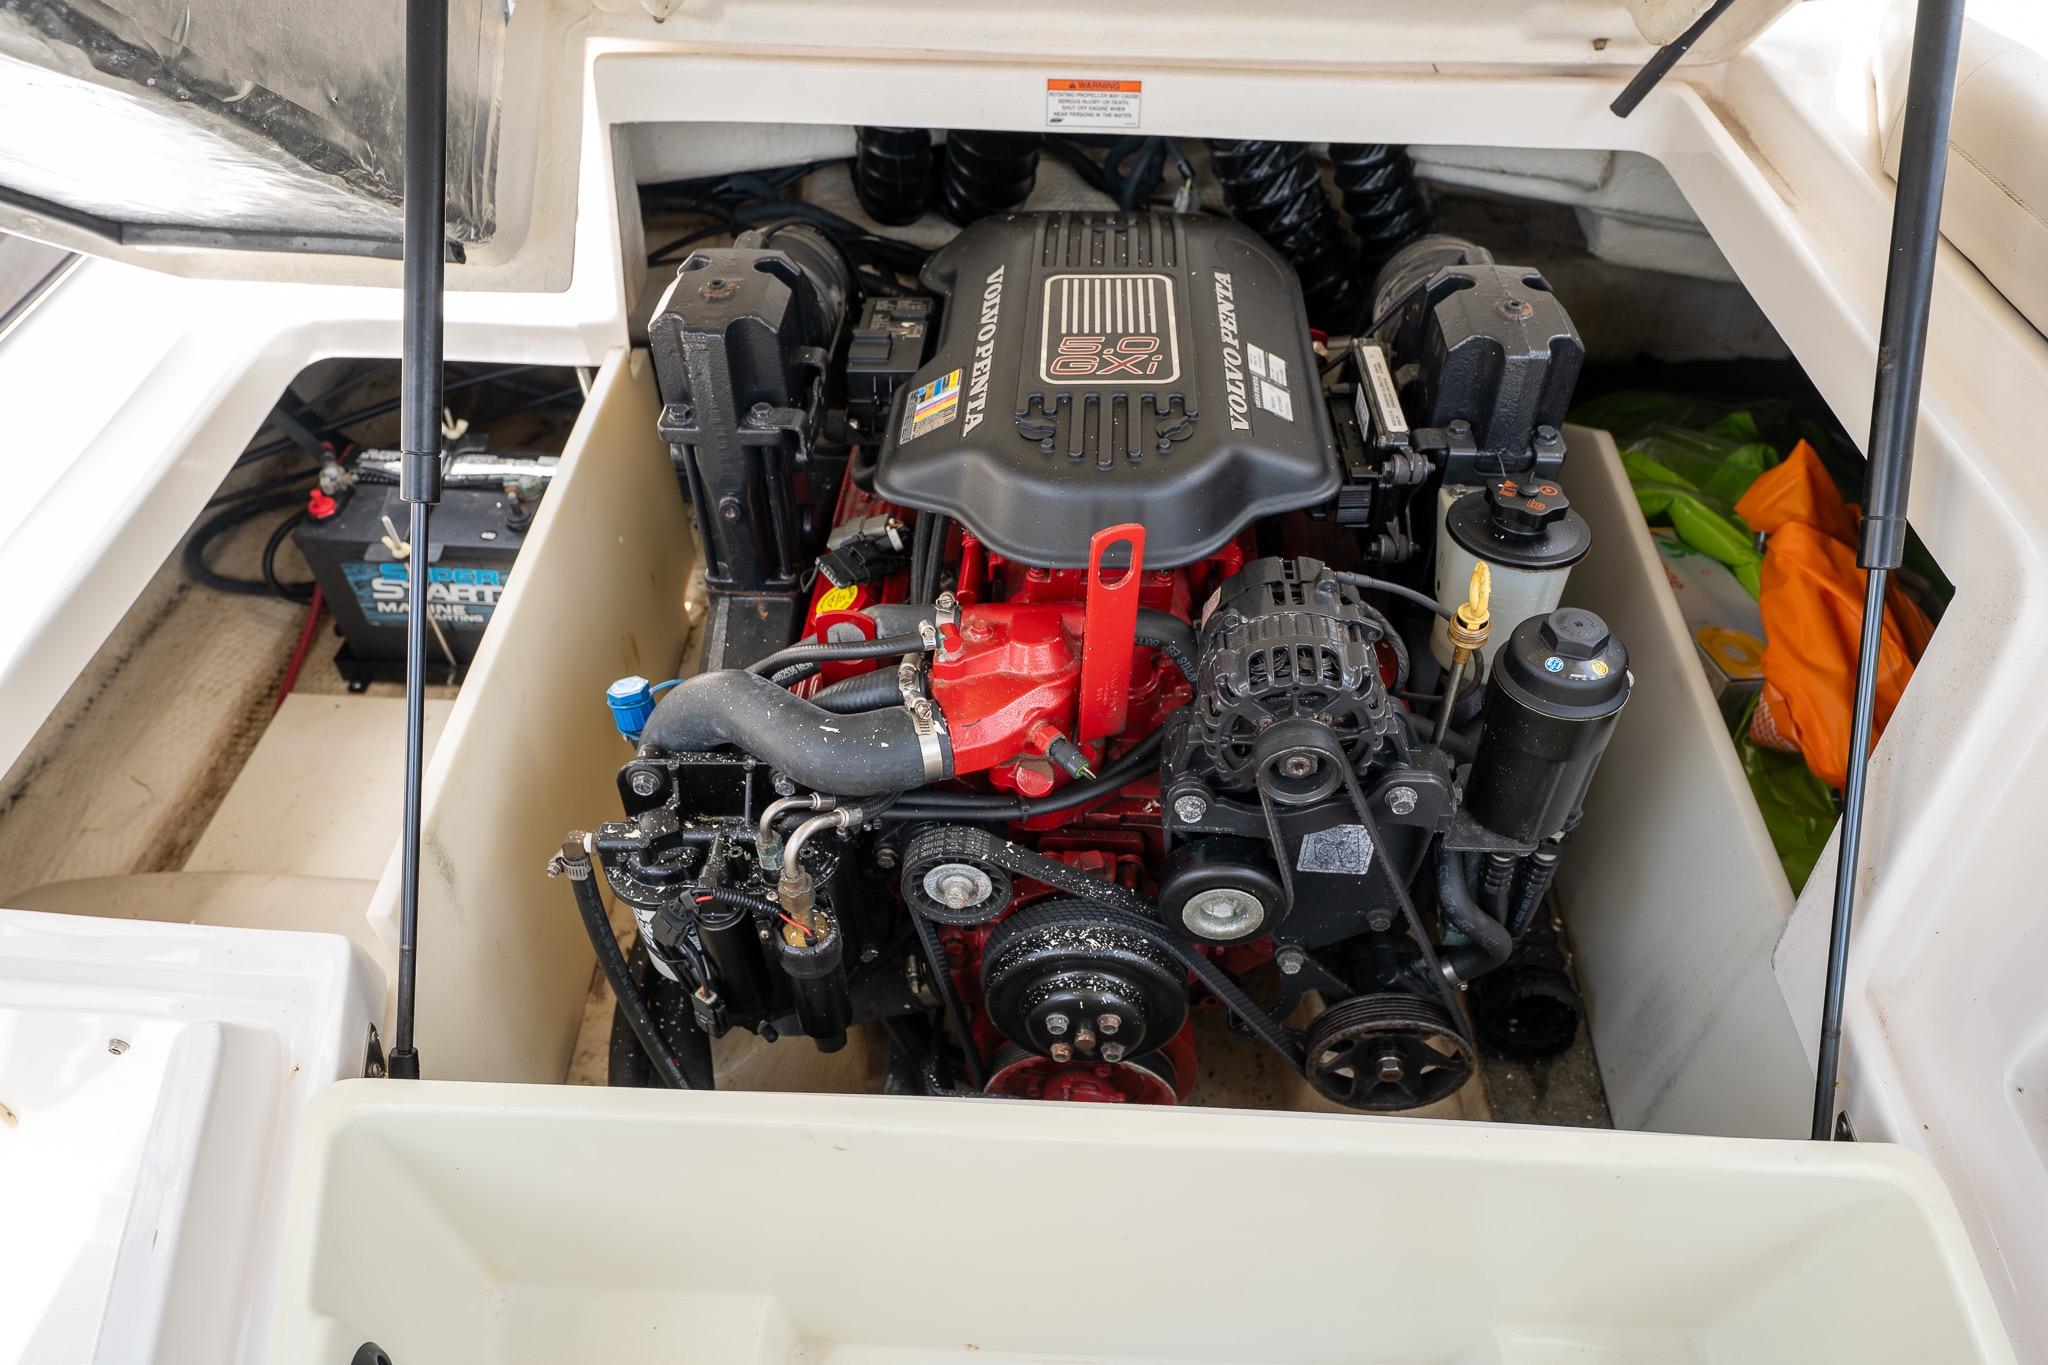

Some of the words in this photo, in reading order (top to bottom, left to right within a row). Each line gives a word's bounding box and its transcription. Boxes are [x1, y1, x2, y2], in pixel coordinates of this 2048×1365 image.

[1078, 80, 1120, 89] WARNING
[977, 264, 1005, 342] VOLVO
[1214, 271, 1240, 350] PENTA
[1058, 336, 1160, 354] 5.0
[1050, 355, 1163, 375] GXi
[962, 339, 995, 438] PENTA
[1222, 347, 1250, 431] VOLVO
[379, 563, 499, 585] SPER
[371, 577, 504, 602] SART
[377, 602, 466, 616] MAINE
